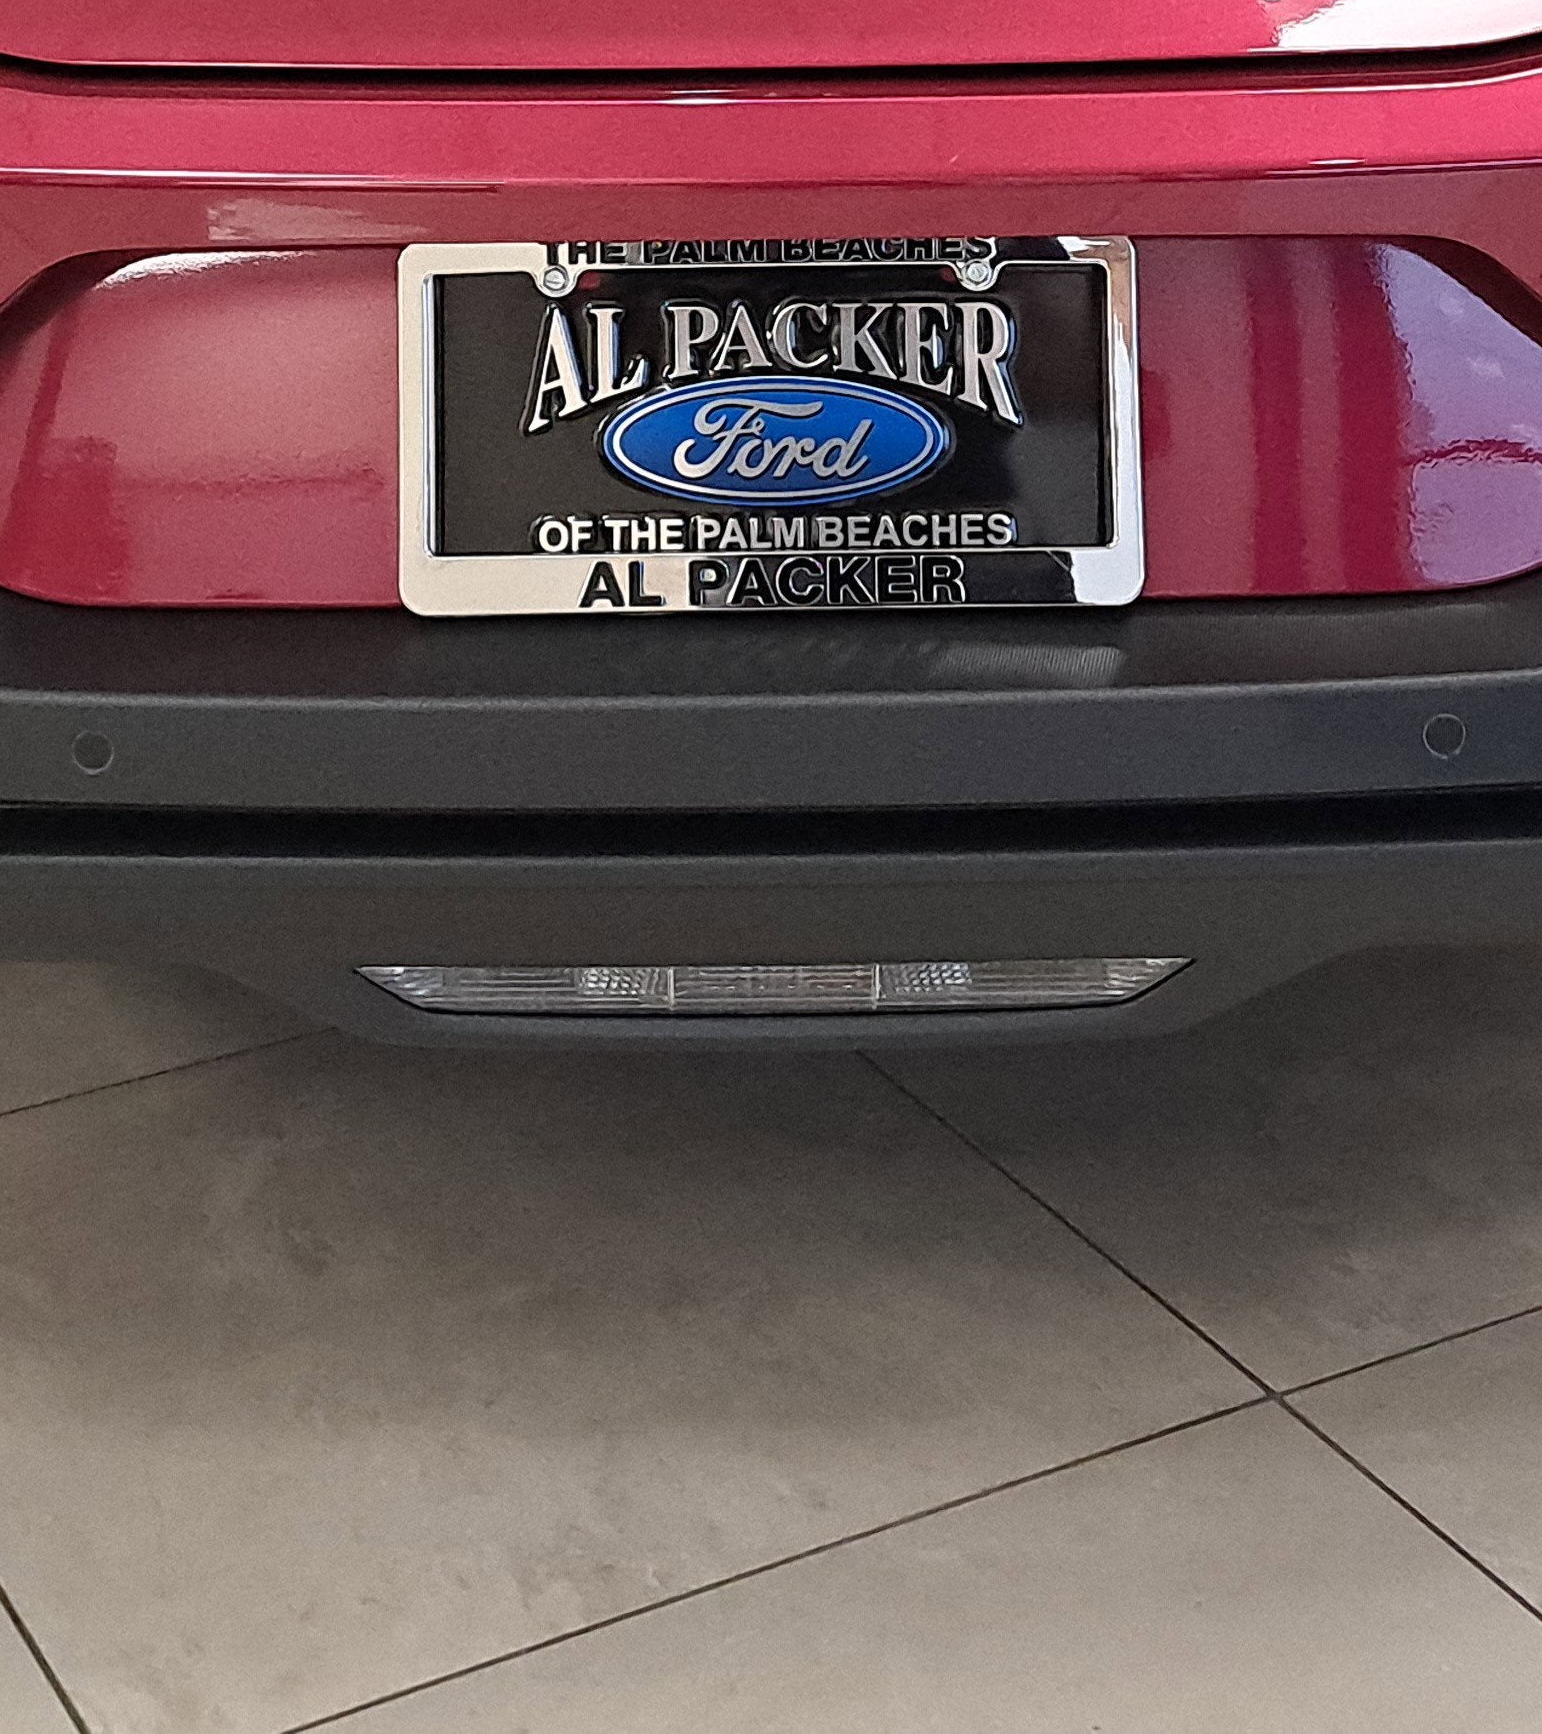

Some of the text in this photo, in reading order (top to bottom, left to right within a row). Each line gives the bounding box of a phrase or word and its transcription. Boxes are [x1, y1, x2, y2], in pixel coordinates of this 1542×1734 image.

[543, 236, 997, 265] THE PALM BEACHES
[522, 299, 1024, 435] AL PACKER
[672, 397, 872, 480] Ford
[538, 512, 1015, 552] OF THE PALM BEACHES
[578, 555, 966, 608] AL PACKER
